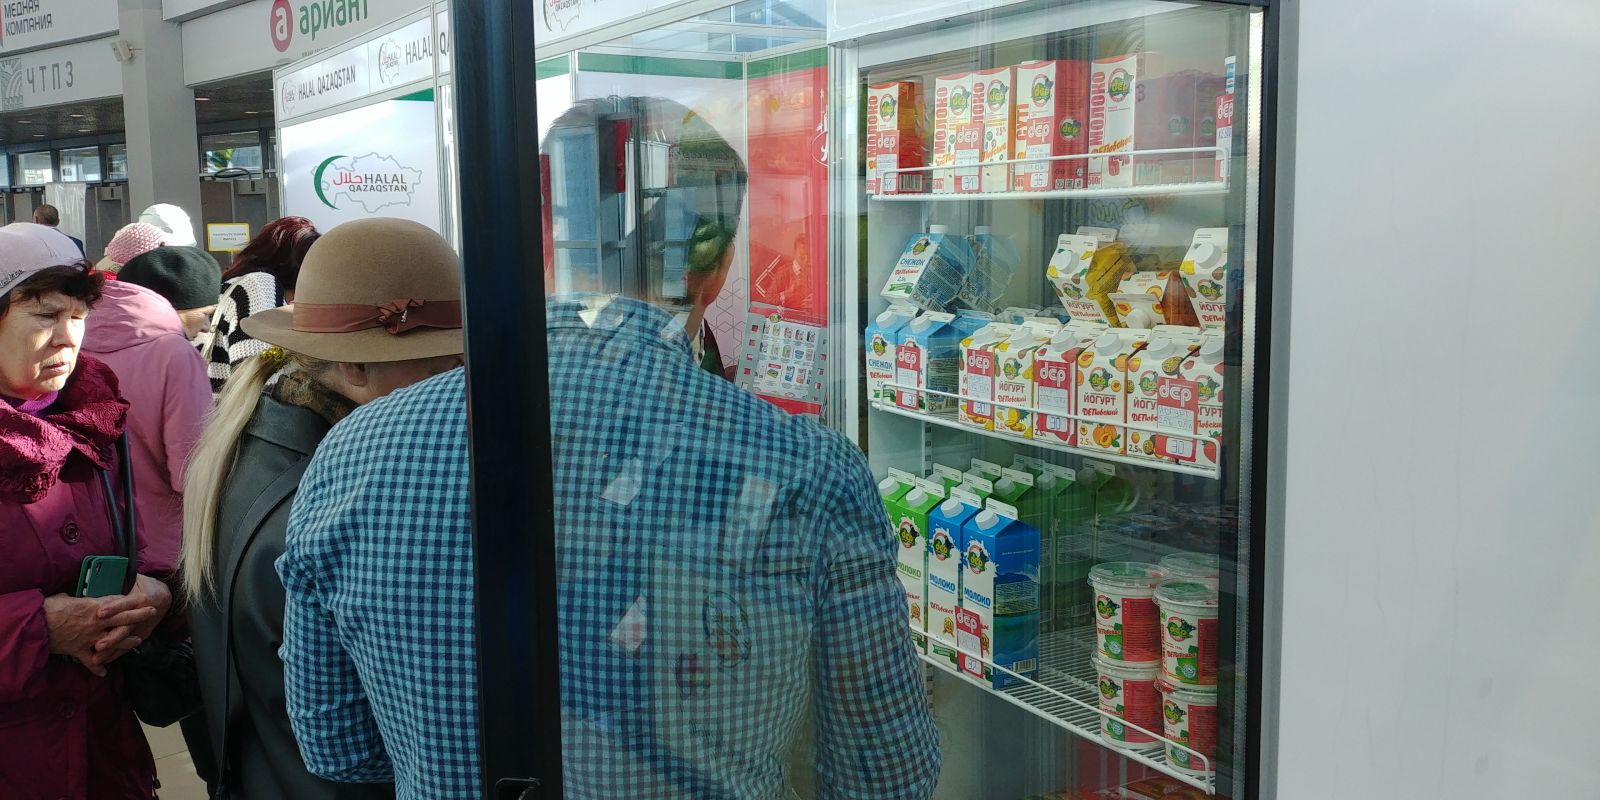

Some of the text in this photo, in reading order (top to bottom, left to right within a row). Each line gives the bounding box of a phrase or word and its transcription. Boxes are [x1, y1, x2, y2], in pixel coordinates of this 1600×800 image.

[3, 0, 40, 18] МЕДНАЯ
[5, 14, 53, 37] КОМПАНИЯ
[405, 35, 433, 65] HALAL
[26, 61, 75, 94] ЧТПЗ
[298, 79, 316, 101] HALAL
[317, 65, 357, 96] QAZAQSTAN
[1089, 71, 1105, 146] МОЛОКО
[867, 95, 878, 158] МОЛОКО
[934, 86, 948, 155] МОЛОКО
[332, 171, 363, 186] حلال
[364, 173, 407, 185] HALAL
[348, 184, 408, 193] QAZAQSTAN
[868, 358, 893, 371] СНЕЖОК
[998, 380, 1026, 394] ЙОГУРТ
[1083, 391, 1117, 406] ЙОГУРТ
[1133, 397, 1157, 411] ЙОГУ
[1081, 407, 1119, 416] ДЕПовский
[1050, 416, 1061, 430] 30
[1170, 439, 1185, 455] 30
[929, 573, 956, 592] МОЛОКО
[964, 587, 991, 607] МОЛОКО
